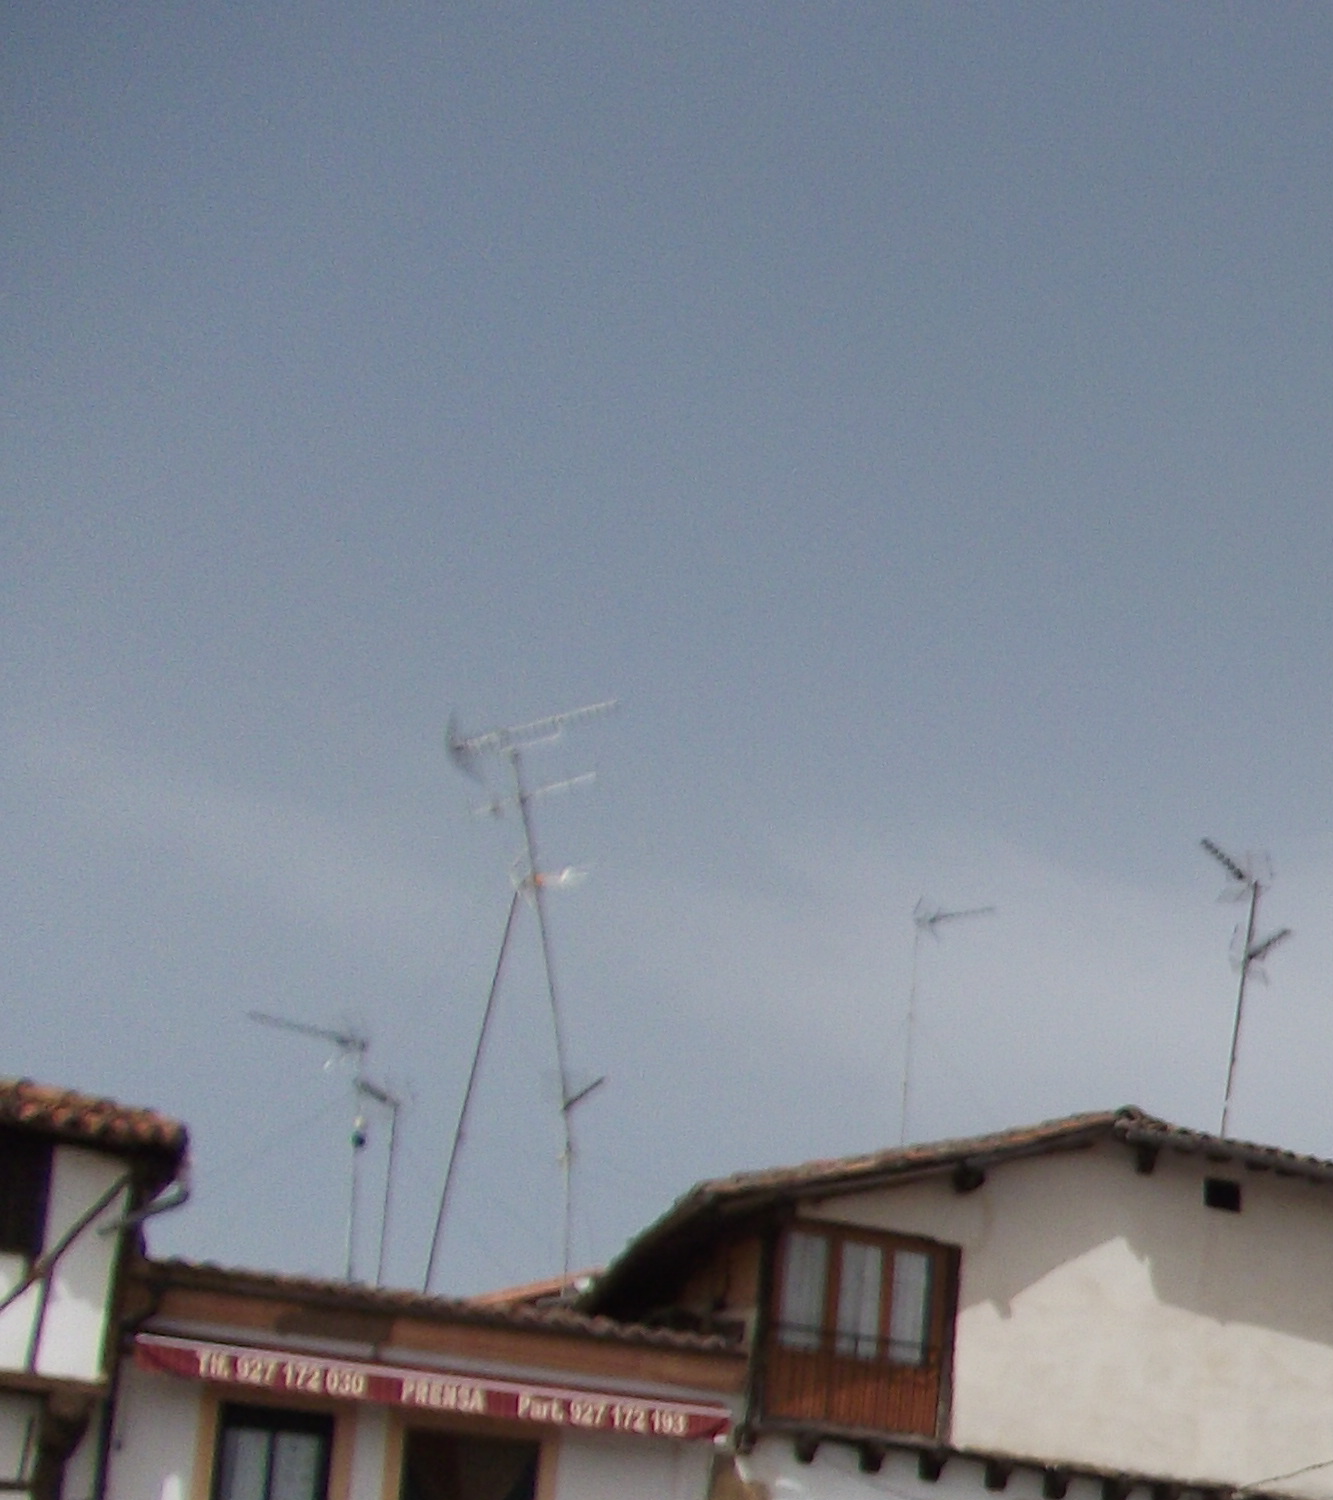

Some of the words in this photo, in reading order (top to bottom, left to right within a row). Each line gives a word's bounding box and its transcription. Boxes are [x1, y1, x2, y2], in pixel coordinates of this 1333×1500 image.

[236, 1357, 276, 1387] 927
[283, 1363, 323, 1393] 172
[326, 1367, 368, 1398] 030
[401, 1377, 485, 1415] PRENSA
[517, 1392, 564, 1424] Part.
[569, 1399, 608, 1428] 927
[611, 1402, 648, 1433] 172
[652, 1408, 688, 1435] 193
